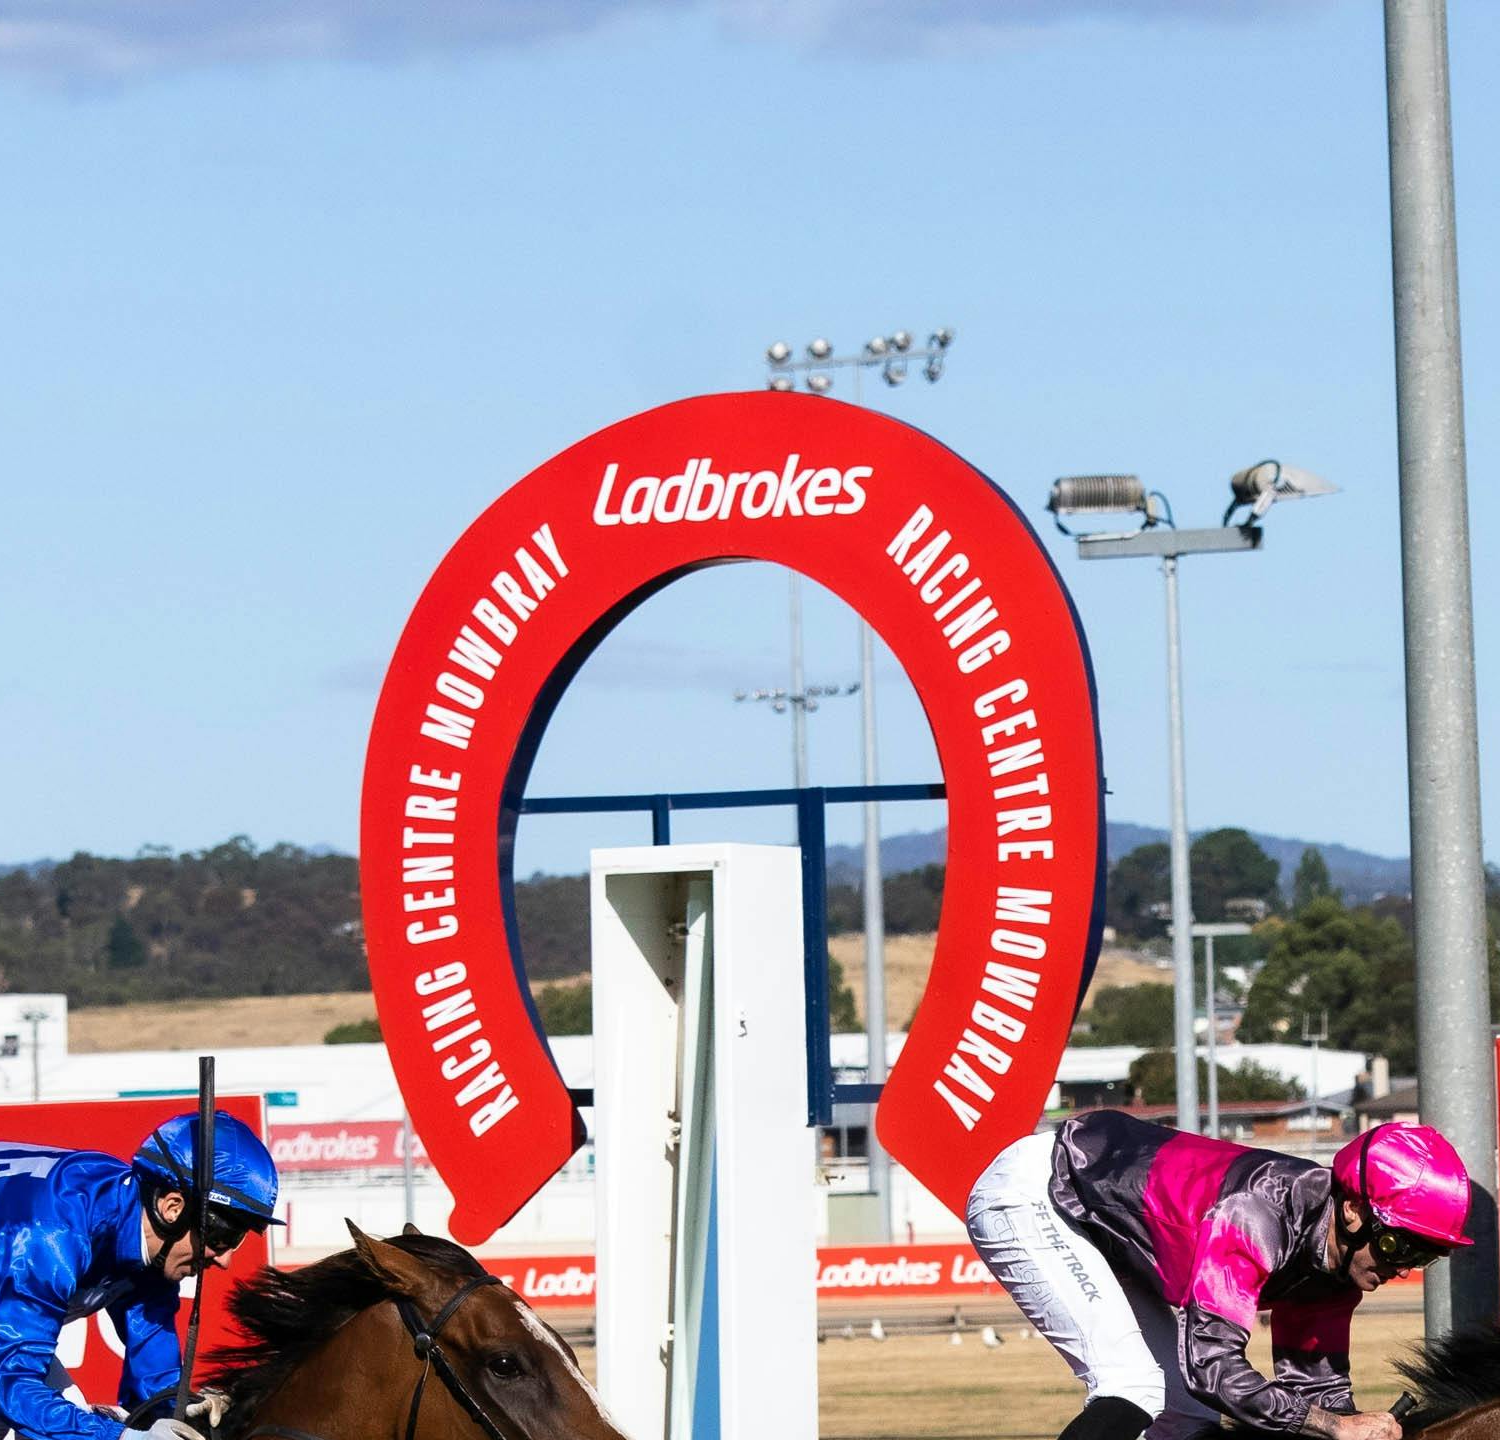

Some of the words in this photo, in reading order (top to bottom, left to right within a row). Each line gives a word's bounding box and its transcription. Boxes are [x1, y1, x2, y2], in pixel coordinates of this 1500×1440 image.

[593, 453, 873, 526] Ladbrokes
[420, 523, 569, 750] MOWBRAY
[885, 504, 1011, 674] RACING
[402, 764, 462, 945] CENTRE
[973, 678, 1054, 862] CENTRE
[414, 961, 520, 1137] RACING
[933, 886, 1053, 1131] MOWBRAY
[266, 1130, 381, 1162] adbrokes
[523, 1266, 597, 1297] Ladbr
[1031, 1200, 1052, 1221] FF
[1062, 1253, 1102, 1302] TRACK
